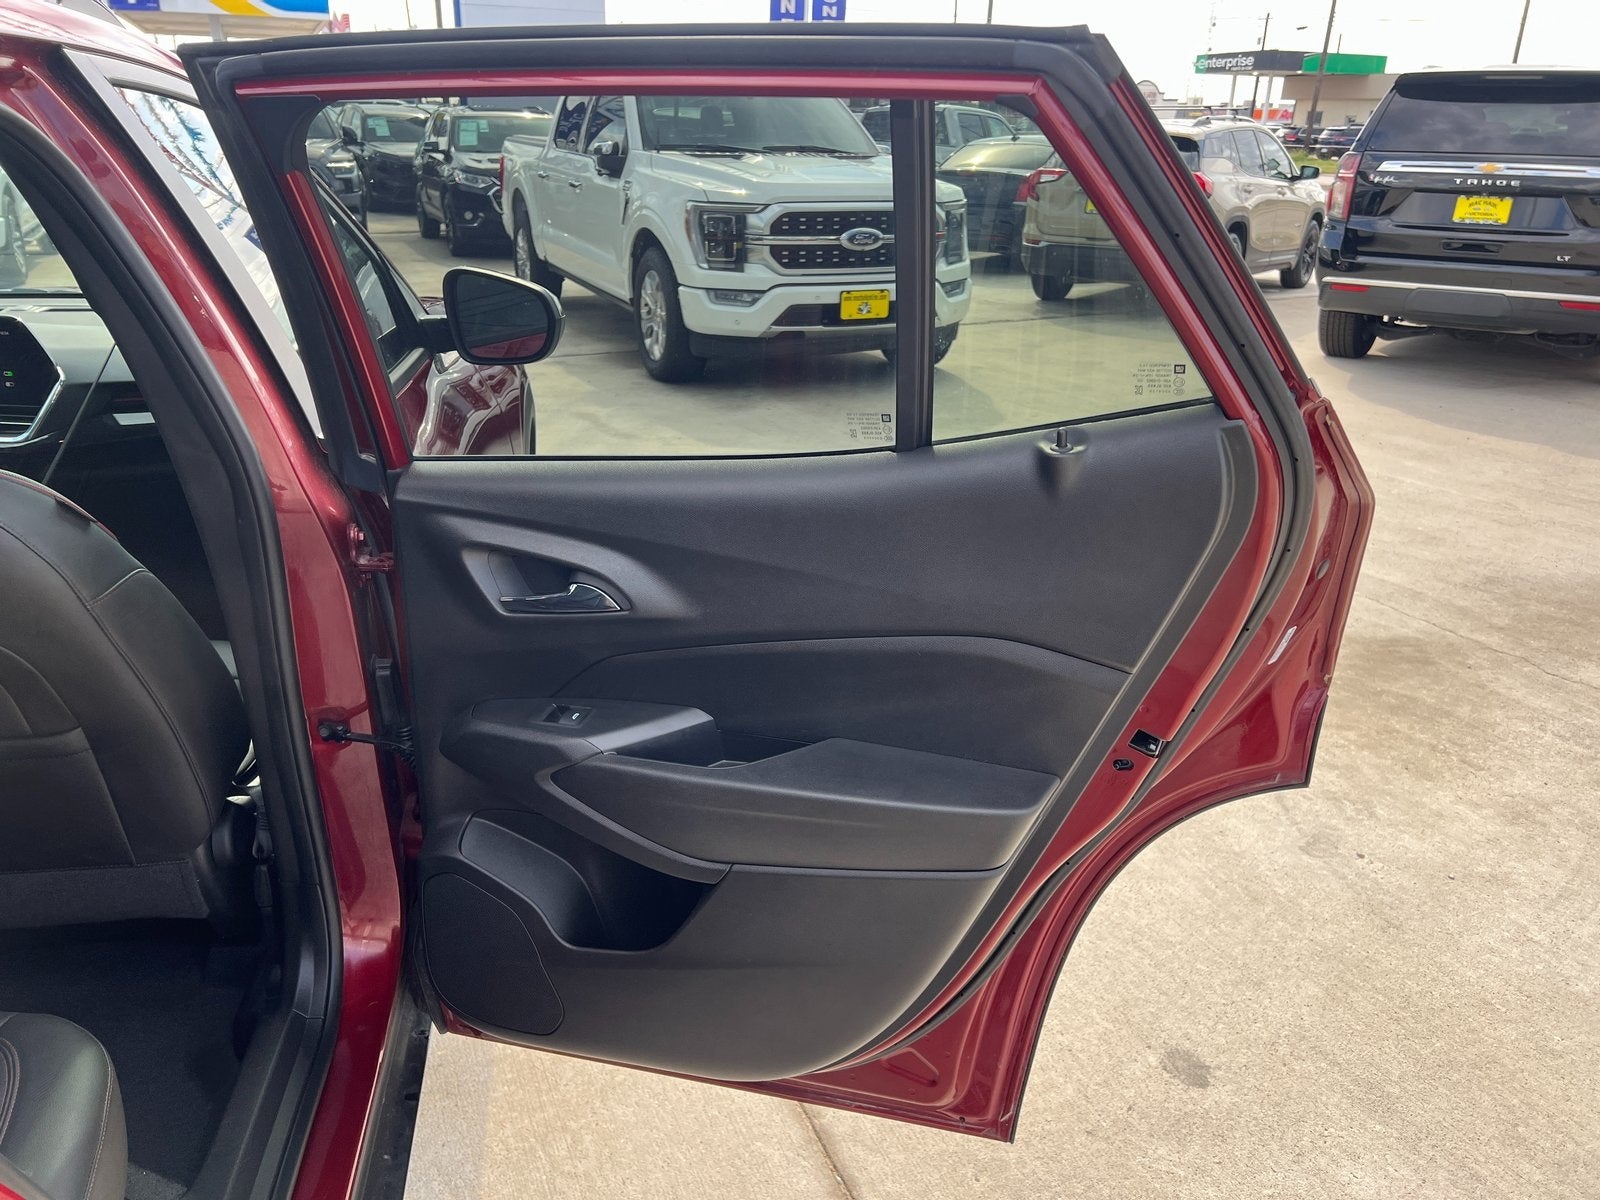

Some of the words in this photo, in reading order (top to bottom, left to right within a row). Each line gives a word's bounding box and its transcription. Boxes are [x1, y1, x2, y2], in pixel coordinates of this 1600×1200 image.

[1198, 54, 1255, 71] enterprise
[1453, 178, 1521, 188] TAHOE
[852, 233, 876, 245] Ford
